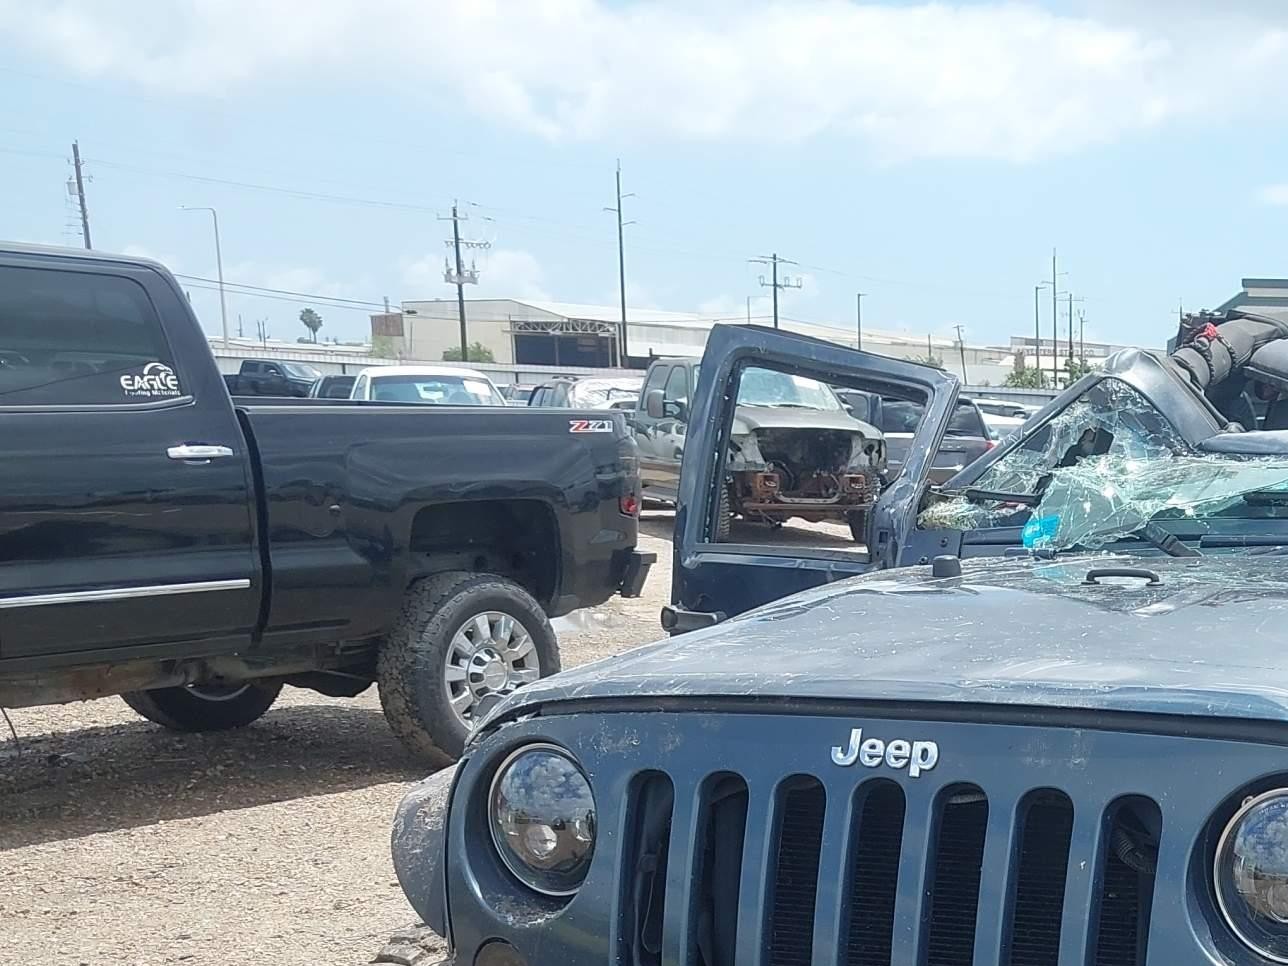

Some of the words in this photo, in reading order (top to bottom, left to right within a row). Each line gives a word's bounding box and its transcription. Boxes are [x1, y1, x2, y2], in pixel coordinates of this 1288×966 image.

[120, 375, 178, 390] EAGLE
[569, 420, 613, 433] Z71
[831, 728, 939, 777] Jeep
